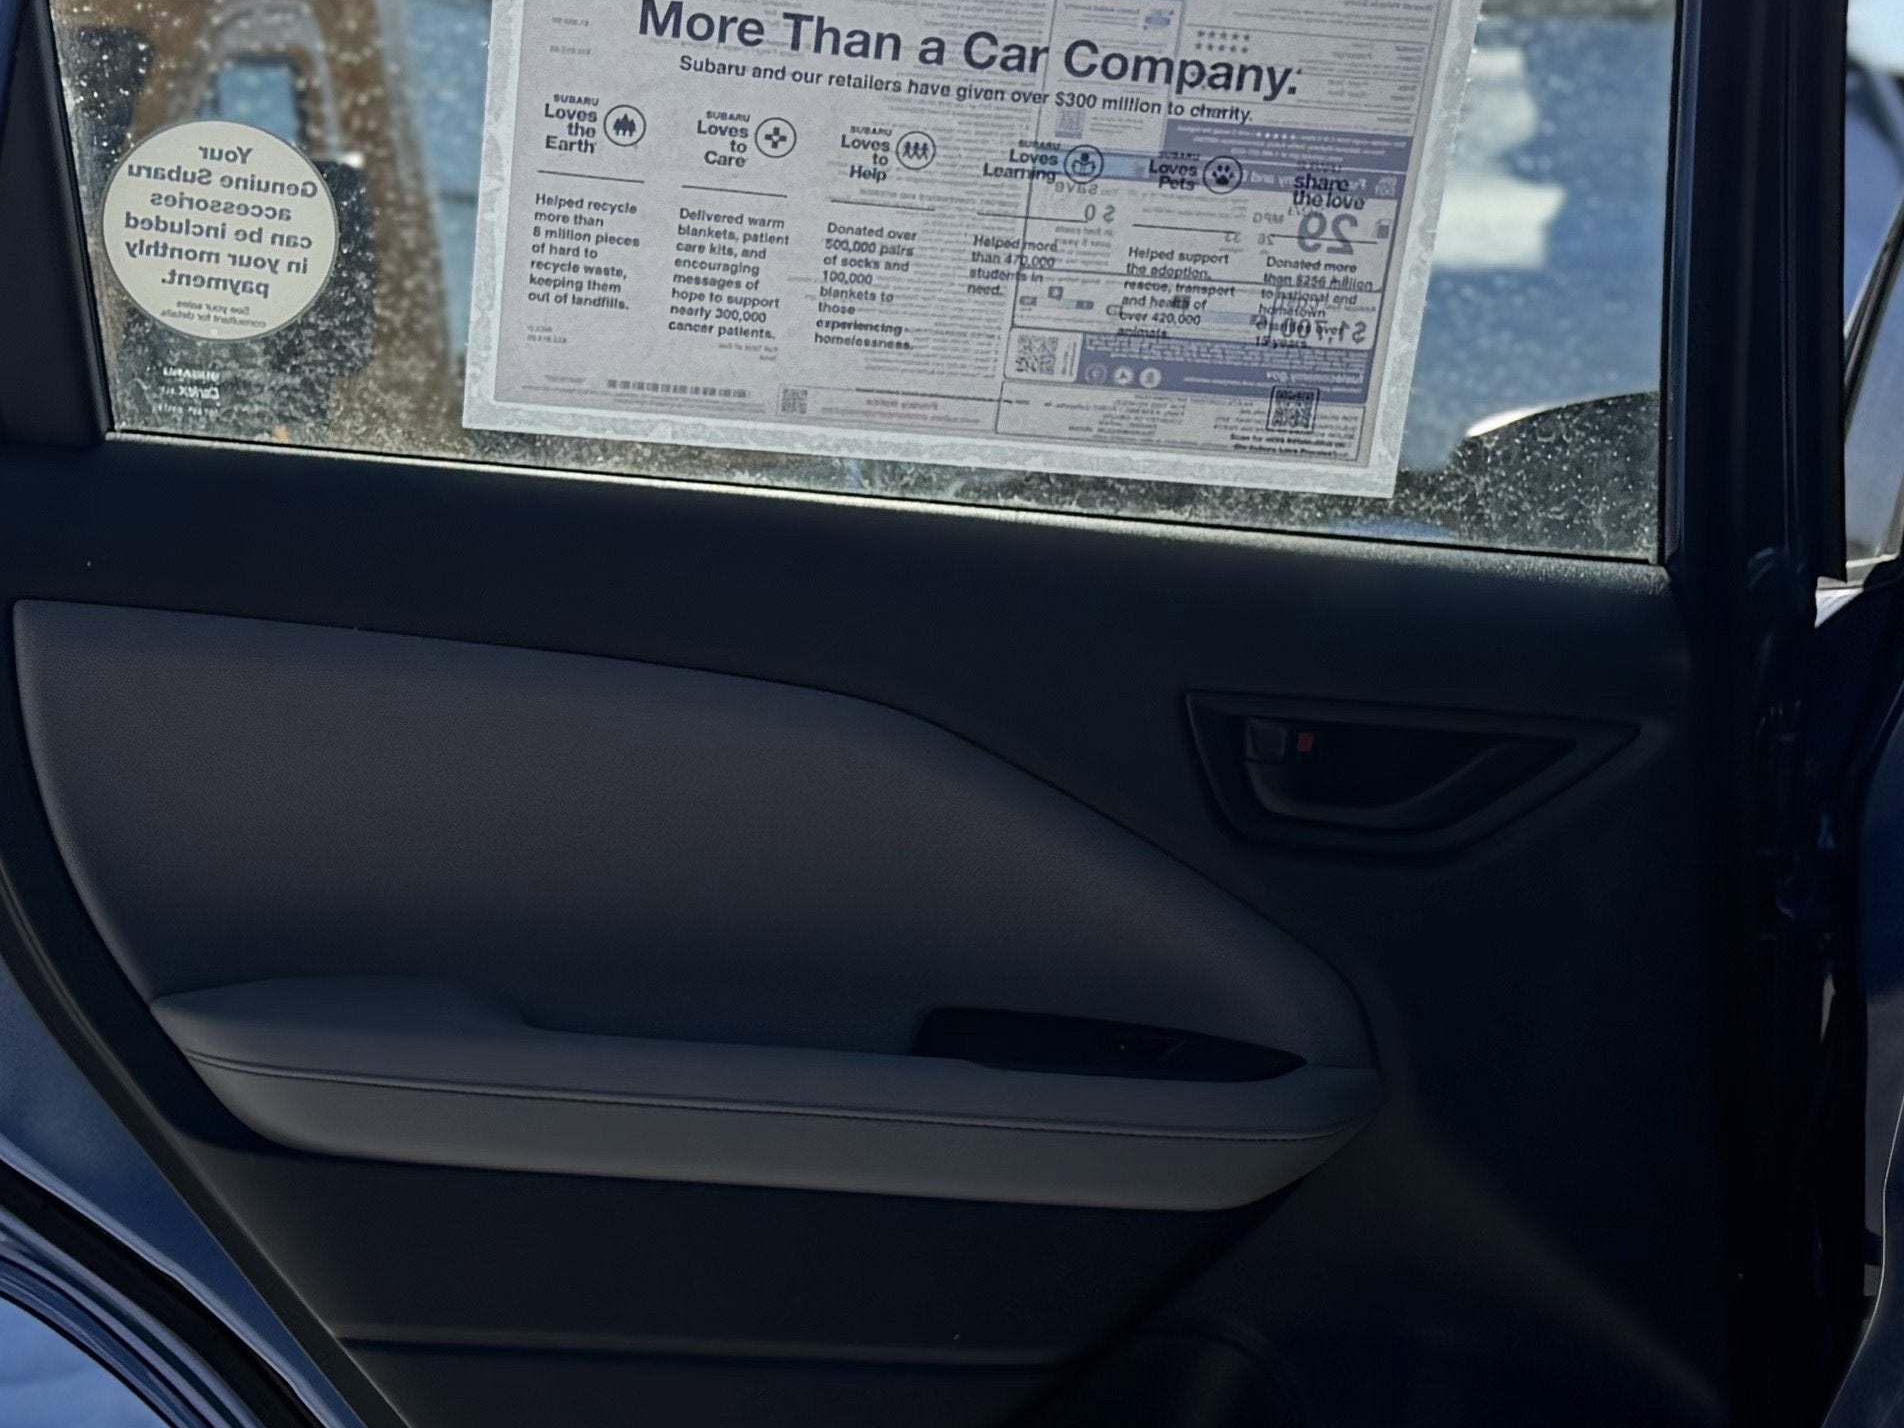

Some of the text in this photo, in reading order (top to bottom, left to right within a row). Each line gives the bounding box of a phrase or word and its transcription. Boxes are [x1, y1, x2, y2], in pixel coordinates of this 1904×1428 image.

[782, 11, 902, 61] Than
[918, 36, 945, 66] a
[963, 31, 1049, 73] Car
[680, 55, 1253, 125] Subaru and our retailers have given over $300 million to charity.
[553, 93, 599, 106] SUBARU
[544, 103, 598, 122] Loves
[706, 110, 751, 122] SUBARU
[567, 122, 596, 138] the
[697, 119, 749, 138] Loves
[850, 125, 892, 137] SUBARU
[545, 135, 596, 154] Earth
[729, 139, 747, 153] to
[841, 134, 890, 152] Loves
[704, 150, 746, 168] Care
[872, 153, 888, 166] to
[1009, 149, 1058, 165] Loves
[849, 164, 887, 184] Help
[983, 162, 1056, 184] Learning
[1149, 158, 1197, 176] Loves
[1159, 175, 1195, 191] Pets
[1294, 173, 1349, 192] share
[535, 192, 637, 215] Helped recycle
[1293, 190, 1365, 210] the love
[534, 211, 604, 227] more than
[679, 207, 784, 229] Delivered warm
[545, 227, 591, 243] million
[595, 232, 640, 248] pieces
[677, 224, 789, 245] blankets, patient
[827, 222, 917, 241] Donated over
[531, 243, 598, 259] of hard to
[676, 242, 767, 259] care kits, and
[825, 238, 914, 256] 500,000 pairs
[973, 235, 1058, 252] Helped more
[823, 255, 910, 272] of socks and
[971, 251, 1000, 264] than
[1128, 246, 1229, 264] Helped support
[530, 259, 627, 280] recycle waste,
[674, 257, 760, 277] encouraging
[1126, 262, 1146, 274] the
[1266, 256, 1357, 273] Donated more
[529, 273, 621, 293] keeping them
[672, 273, 760, 291] messages of
[823, 270, 873, 285] 100,000
[969, 267, 1043, 282] students in
[1263, 273, 1373, 291] than million
[671, 287, 780, 308] hope to support
[819, 286, 894, 303] blankets to
[967, 283, 1003, 296] need.
[1124, 280, 1235, 297] rescue, transport
[1261, 288, 1273, 299] to
[1333, 294, 1357, 305] and
[528, 290, 629, 310] out of landfills.
[818, 302, 856, 315] those
[1122, 295, 1207, 310] and of
[670, 304, 711, 320] nearly
[1119, 312, 1201, 326] over 420,000
[668, 320, 776, 340] cancer patients.
[816, 319, 903, 337] experiencing
[814, 332, 914, 350] homelessness.
